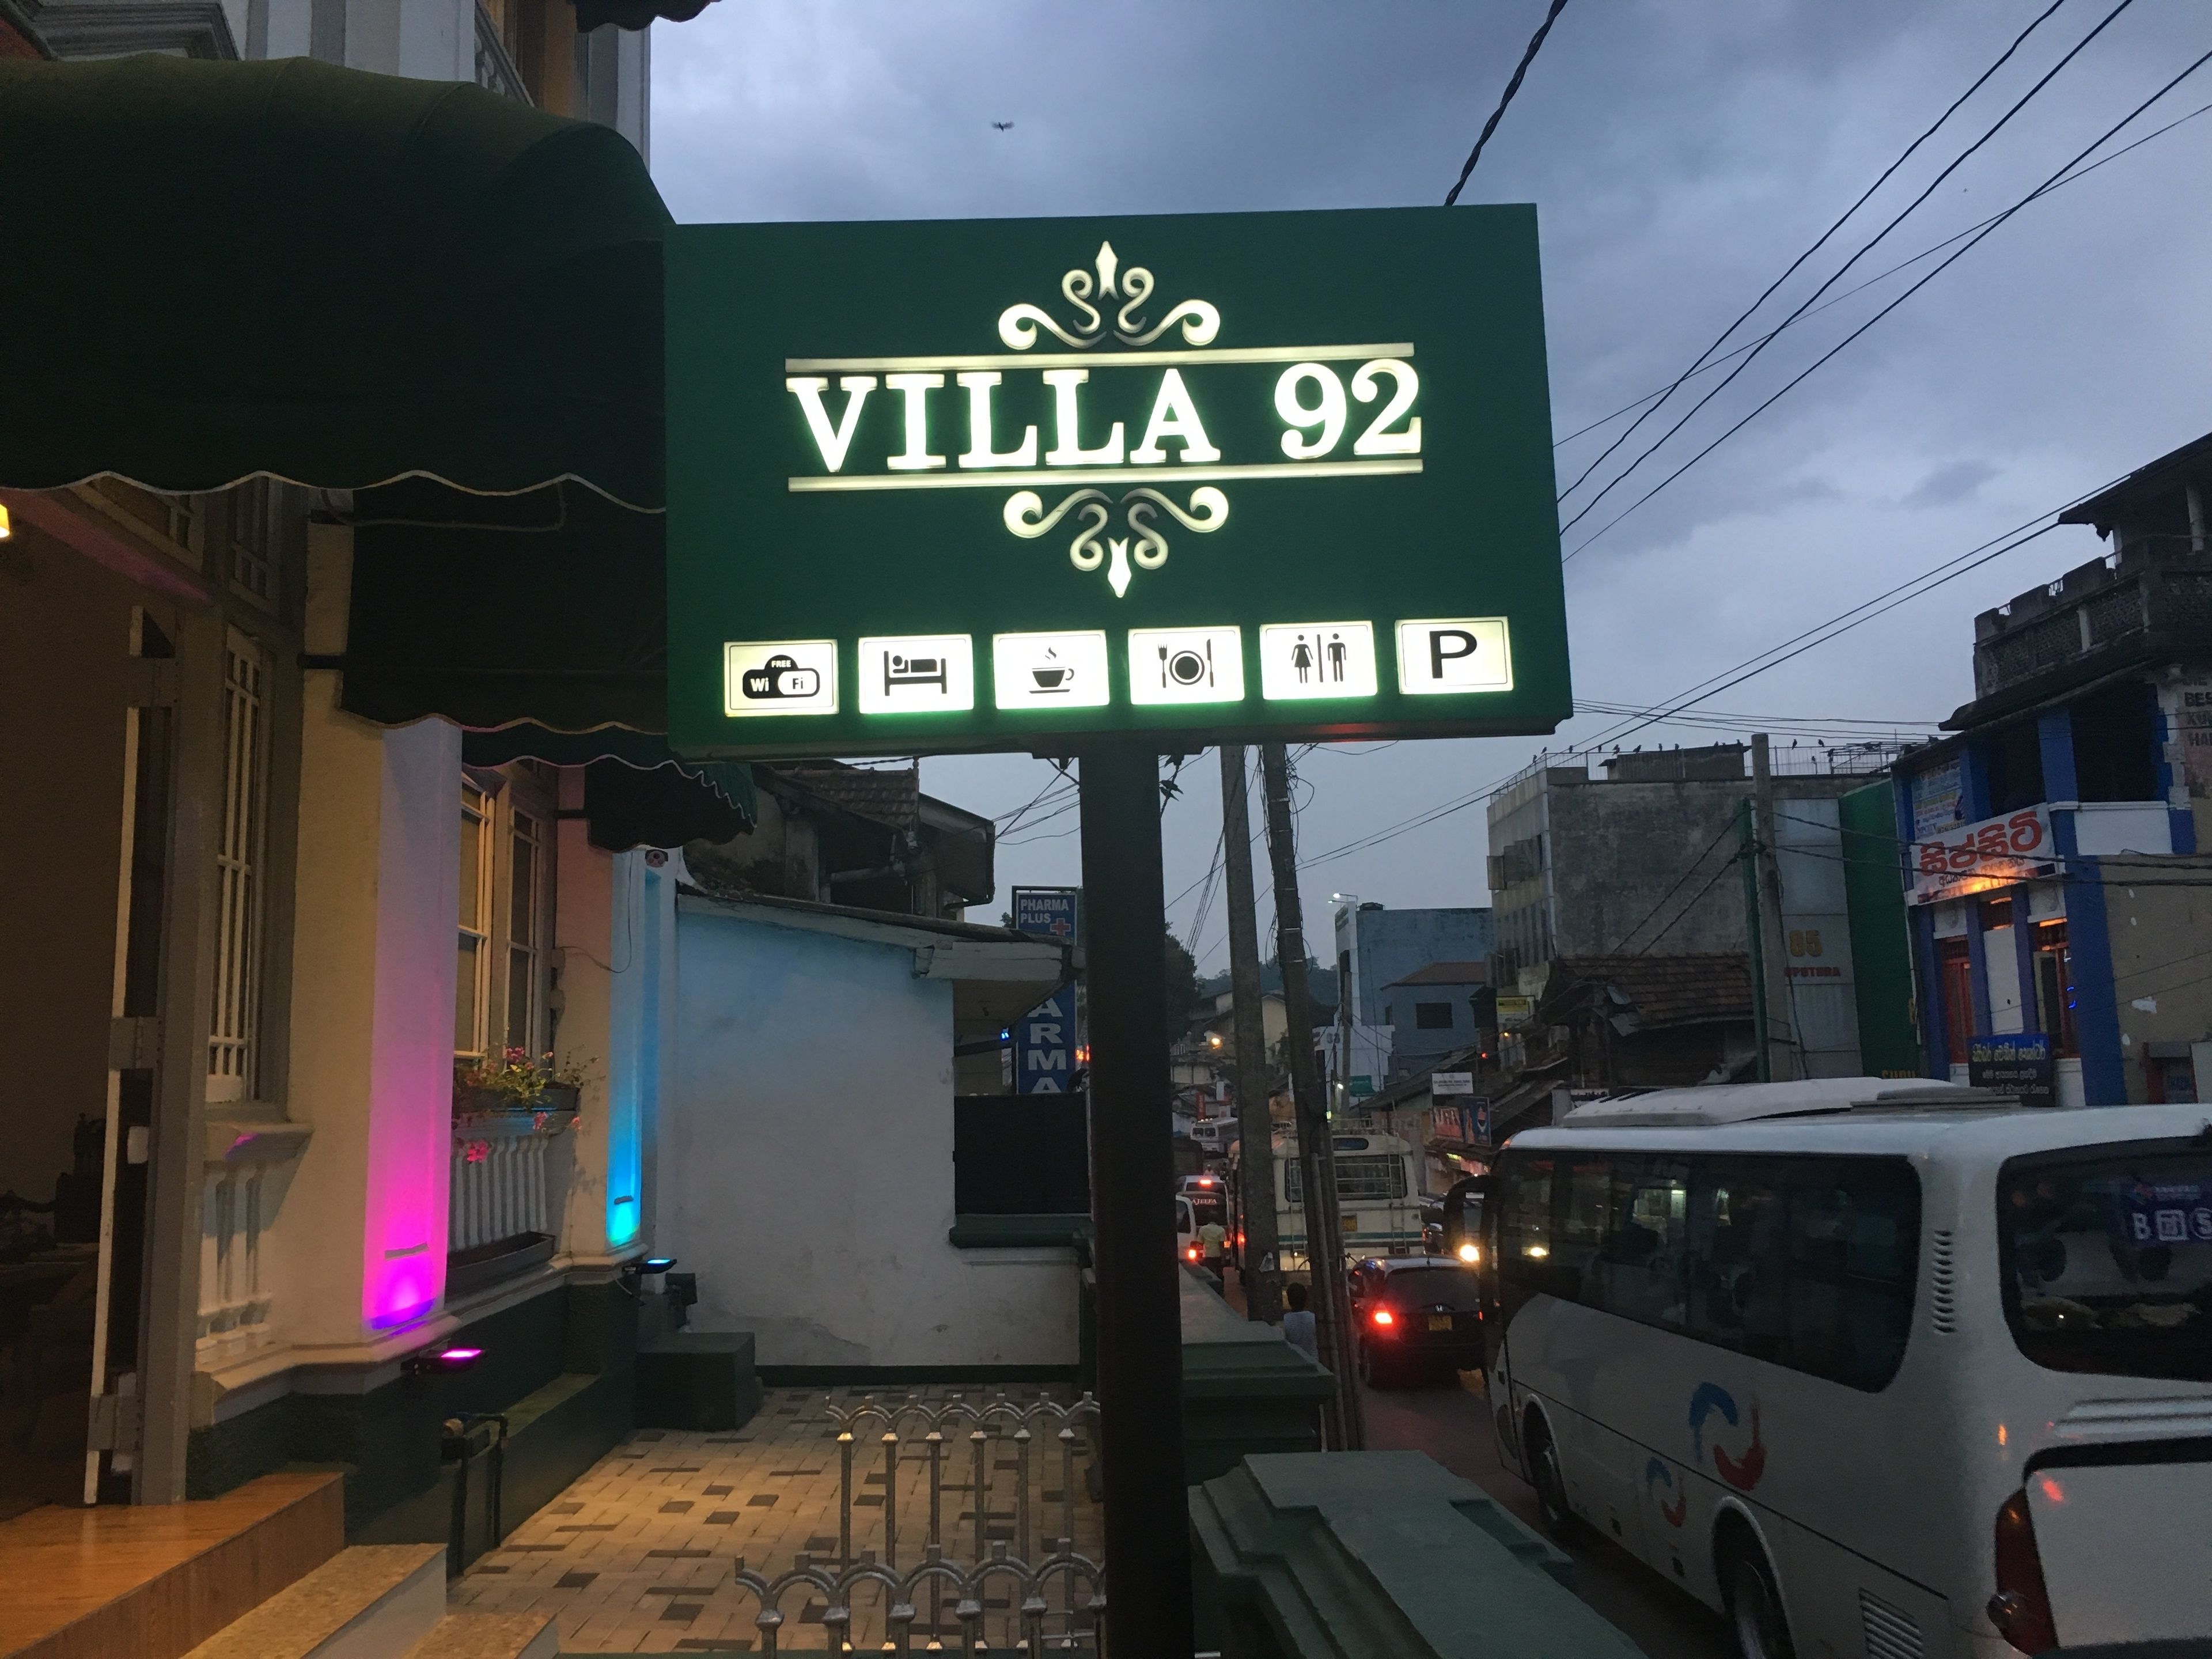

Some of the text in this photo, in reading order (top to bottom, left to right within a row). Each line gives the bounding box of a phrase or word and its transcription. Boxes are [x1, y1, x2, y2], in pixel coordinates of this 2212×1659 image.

[786, 359, 1422, 473] VILLA 92
[1430, 630, 1478, 679] P
[750, 677, 804, 692] Wi Fi
[1020, 899, 1069, 911] PHARMA
[1020, 913, 1051, 923] PLUS
